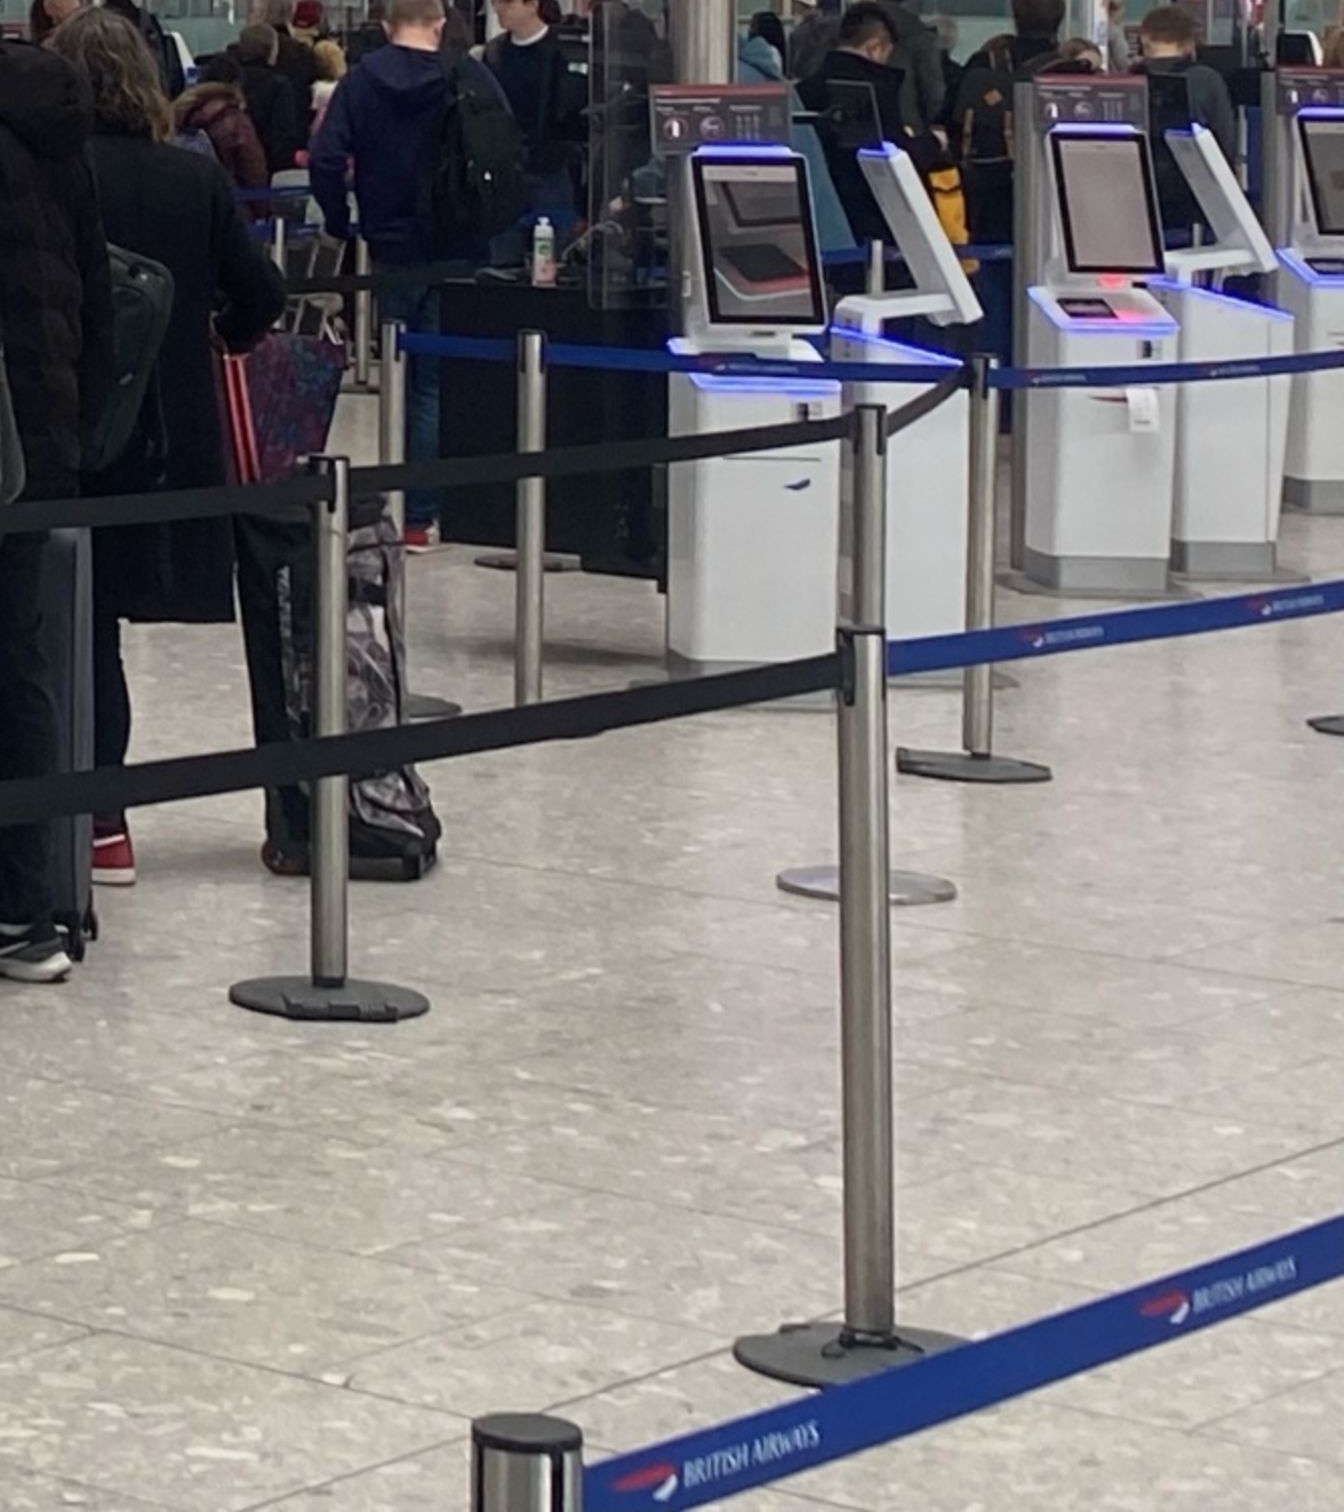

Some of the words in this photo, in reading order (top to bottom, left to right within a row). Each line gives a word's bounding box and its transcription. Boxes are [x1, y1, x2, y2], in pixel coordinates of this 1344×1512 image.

[1193, 1274, 1244, 1314] BRITISH
[683, 1441, 749, 1489] BRITISH
[751, 1418, 820, 1465] AIRWAYS
